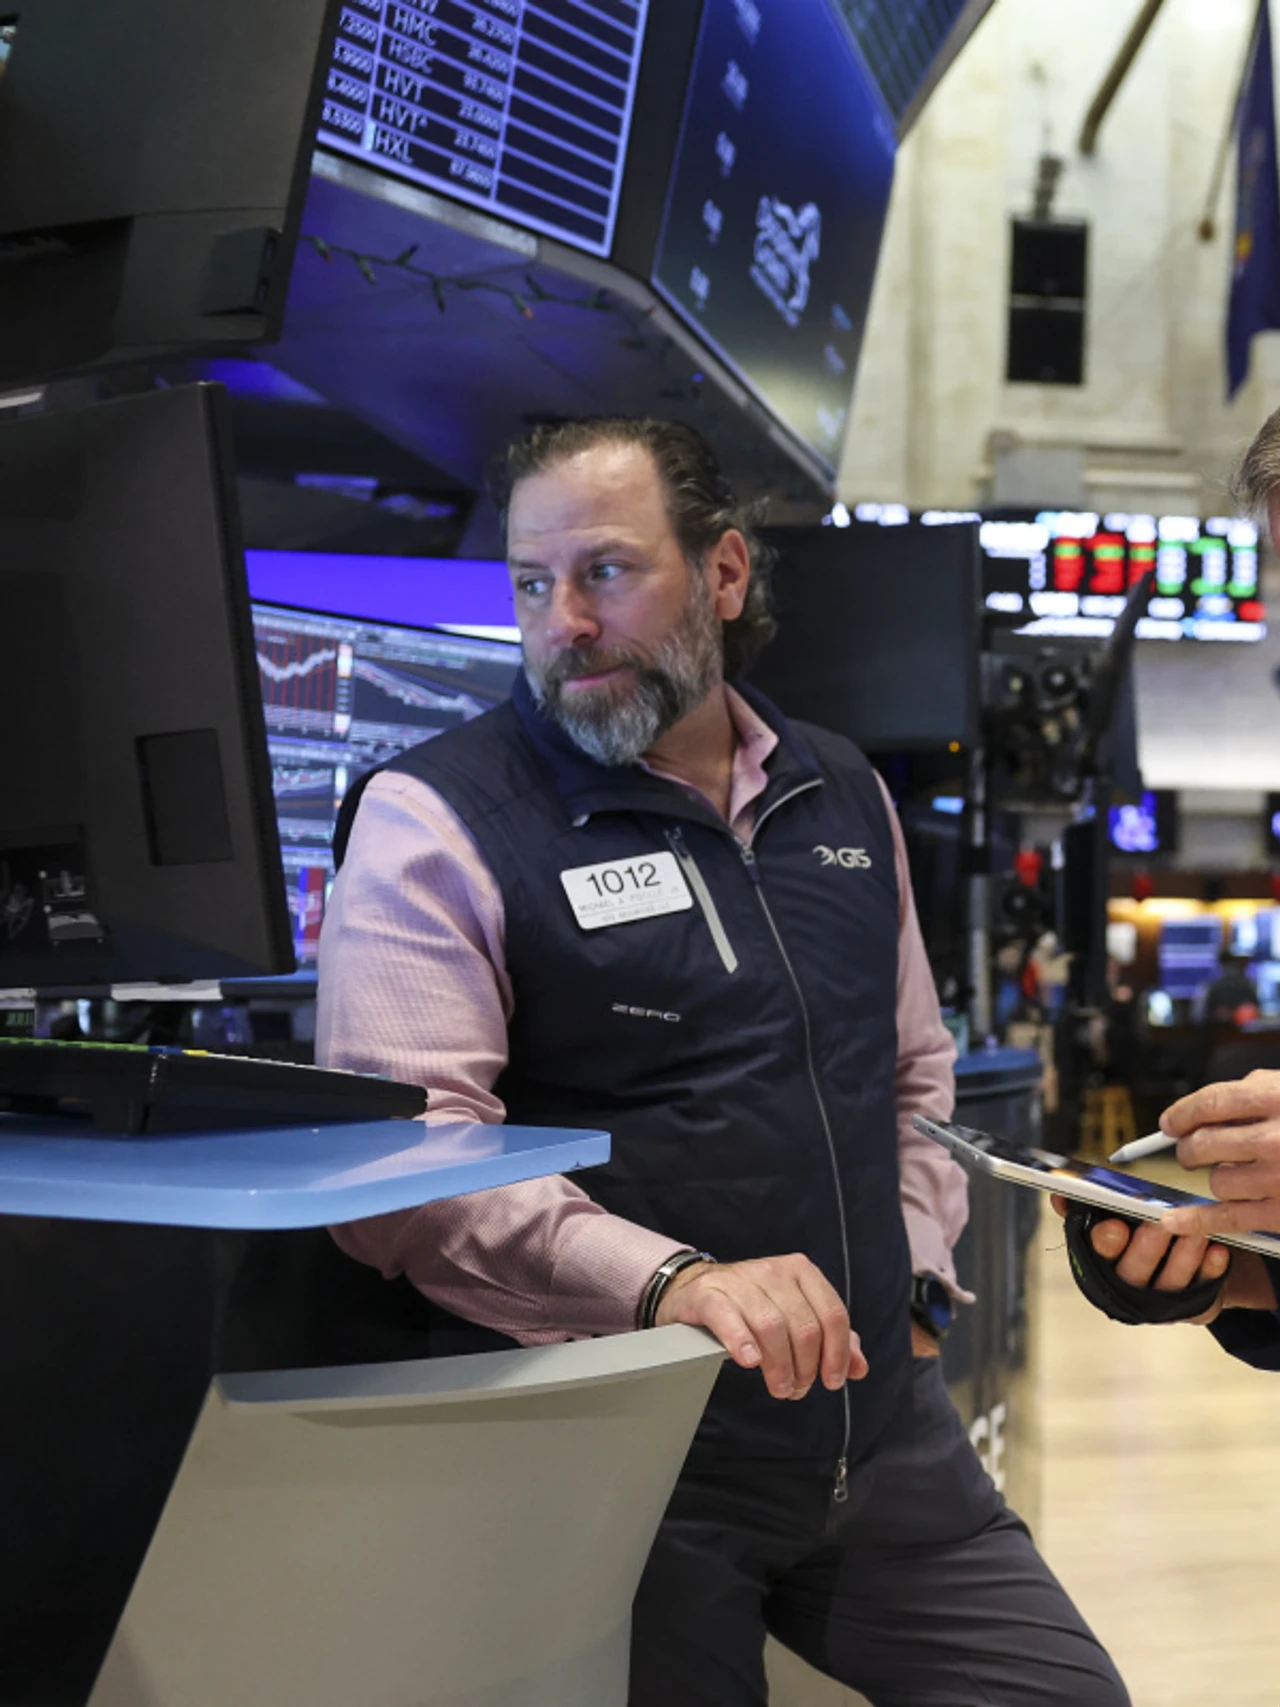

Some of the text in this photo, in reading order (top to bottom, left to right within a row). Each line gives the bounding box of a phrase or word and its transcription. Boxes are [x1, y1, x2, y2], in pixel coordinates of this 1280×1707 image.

[393, 7, 438, 46] HMC
[384, 66, 424, 103] HVT
[375, 129, 414, 165] HXL
[586, 861, 662, 897] 1012
